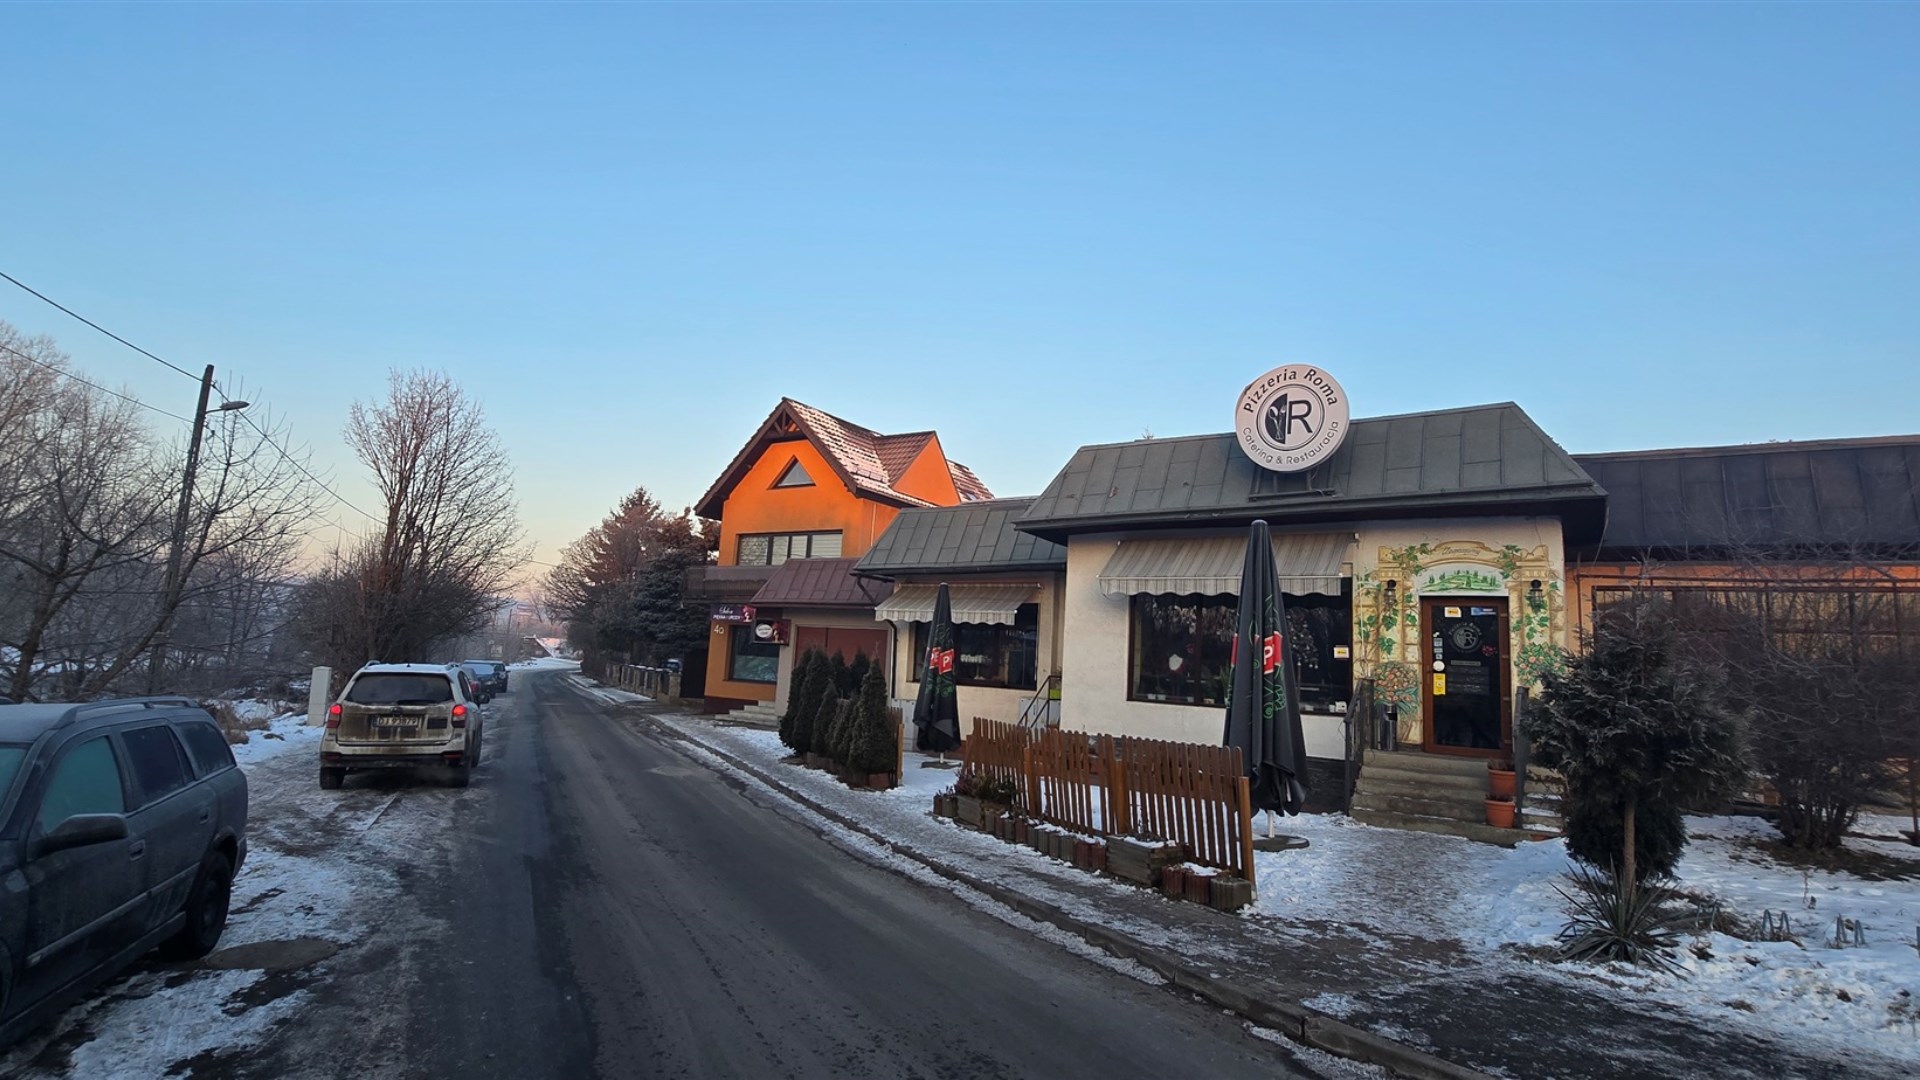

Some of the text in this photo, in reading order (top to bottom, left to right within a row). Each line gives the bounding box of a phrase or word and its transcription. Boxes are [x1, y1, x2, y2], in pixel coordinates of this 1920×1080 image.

[1243, 368, 1338, 413] Pizzeria Roma
[1287, 399, 1313, 435] R
[1243, 421, 1339, 465] Catering & Restauracja
